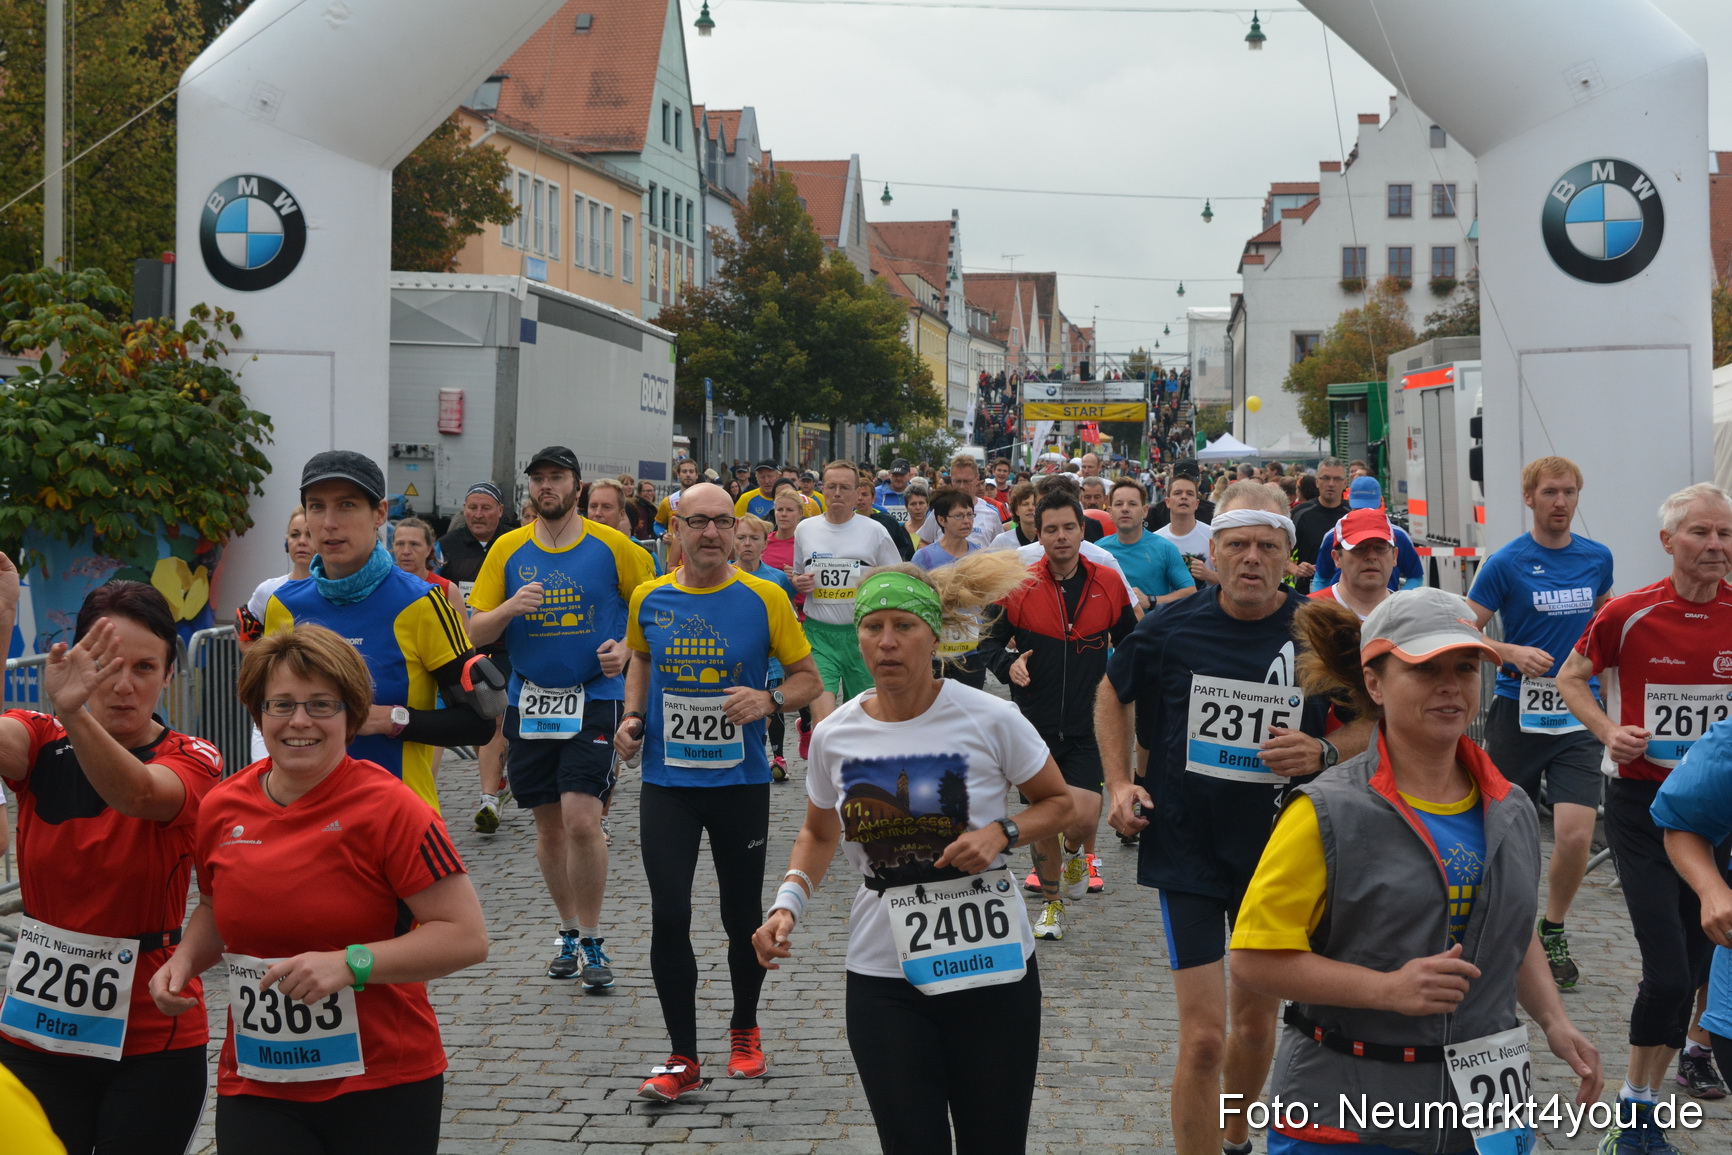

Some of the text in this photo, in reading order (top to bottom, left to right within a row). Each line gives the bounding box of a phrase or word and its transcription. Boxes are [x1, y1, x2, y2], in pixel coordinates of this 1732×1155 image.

[1552, 161, 1656, 204] BMW
[207, 177, 298, 216] BMW
[641, 373, 669, 415] BOCK
[1063, 406, 1105, 417] START
[821, 570, 850, 586] 637
[818, 589, 854, 599] Stefan
[1532, 587, 1593, 605] HUBER
[1548, 601, 1592, 610] TECHNOLOGY
[525, 694, 578, 715] 2620
[1194, 685, 1284, 705] PARTL Neumarkt
[1647, 693, 1724, 701] PARTL Neumarkt
[665, 701, 687, 711] PARTL
[537, 721, 561, 732] Ronny
[671, 713, 736, 741] 2426
[1540, 717, 1567, 726] Simon
[684, 747, 723, 759] Norbert
[844, 802, 870, 817] 11.
[935, 883, 992, 901] Neumarkt
[905, 899, 1010, 953] 2406
[20, 929, 113, 961] PARTL Neumarkt
[230, 964, 262, 980] PARTL
[932, 954, 994, 977] Claudia
[15, 950, 120, 1011] 2266
[240, 985, 343, 1034] 2363
[36, 1012, 78, 1037] Petra
[258, 1046, 321, 1065] Monika
[1450, 1050, 1497, 1072] PARTL
